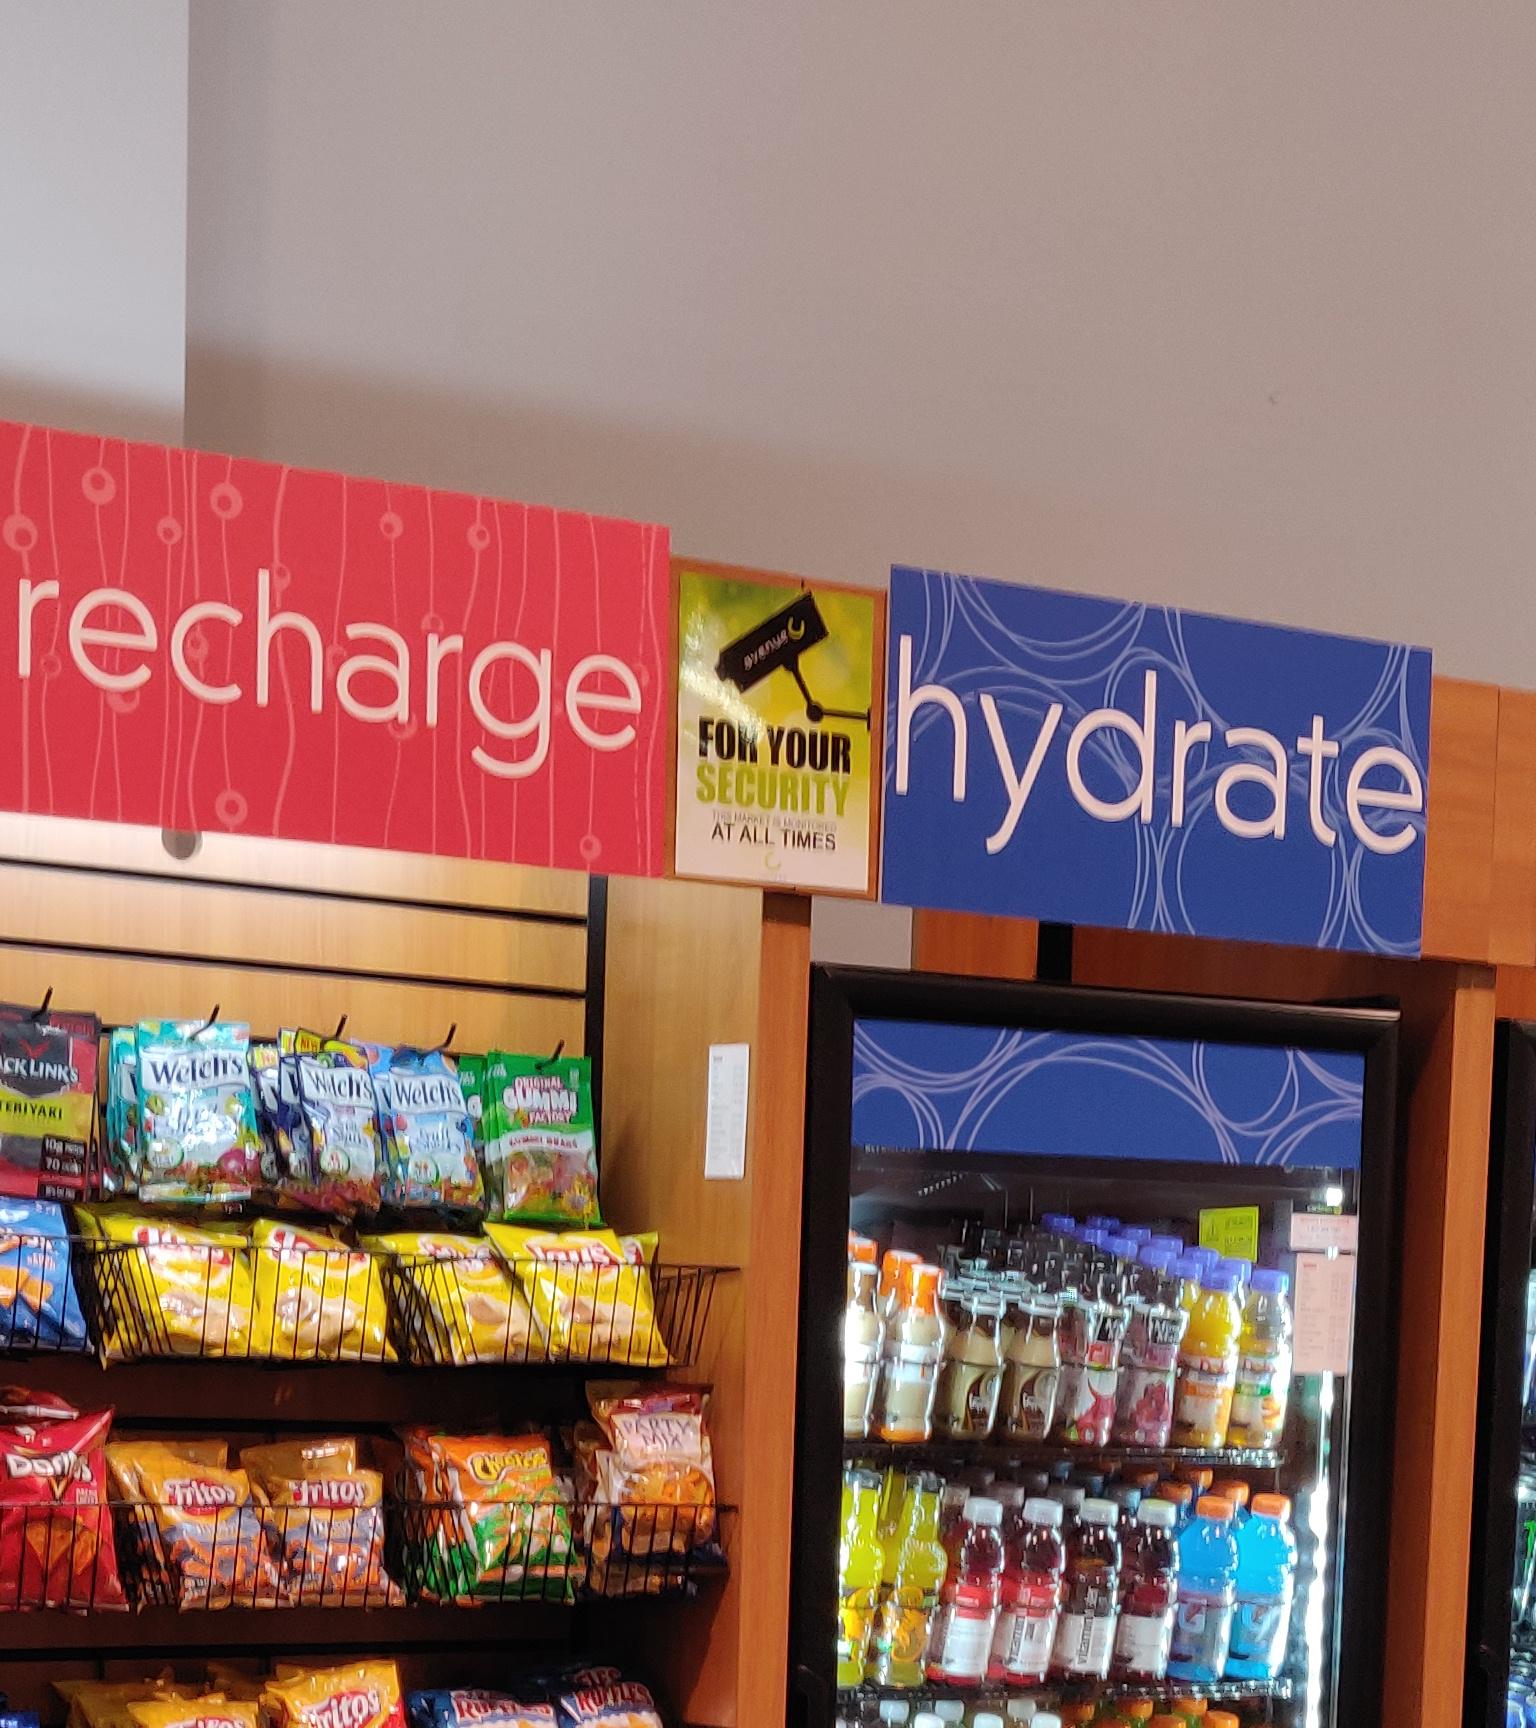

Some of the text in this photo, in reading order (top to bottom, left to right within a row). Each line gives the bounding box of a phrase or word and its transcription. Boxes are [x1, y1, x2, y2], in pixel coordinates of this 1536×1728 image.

[17, 567, 644, 780] recharge
[698, 715, 852, 775] FOR YOUR
[894, 633, 1423, 856] hydrate
[696, 761, 852, 818] SECURITY
[710, 822, 837, 851] AT ALL TIMES
[150, 1050, 244, 1089] Welch's
[393, 1075, 462, 1107] Welch's
[622, 1418, 693, 1436] PARTY
[641, 1431, 683, 1451] MIX
[164, 1477, 237, 1508] Fritos
